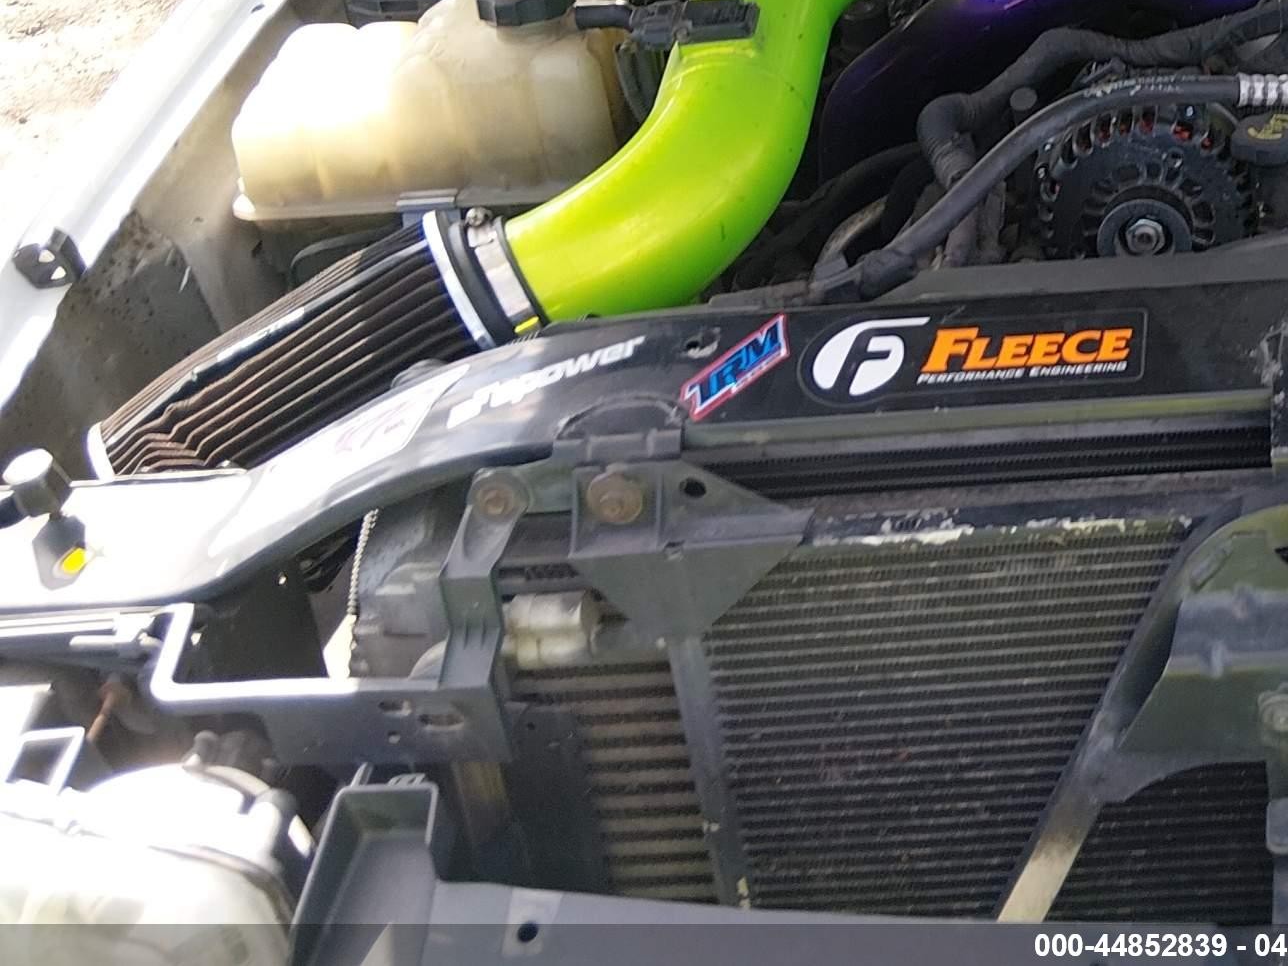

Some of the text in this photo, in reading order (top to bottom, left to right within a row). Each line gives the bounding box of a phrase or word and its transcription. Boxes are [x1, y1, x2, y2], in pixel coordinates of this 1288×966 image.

[921, 327, 1134, 373] FLEECE
[916, 361, 1129, 386] PERFORMANCE ENGINEERING
